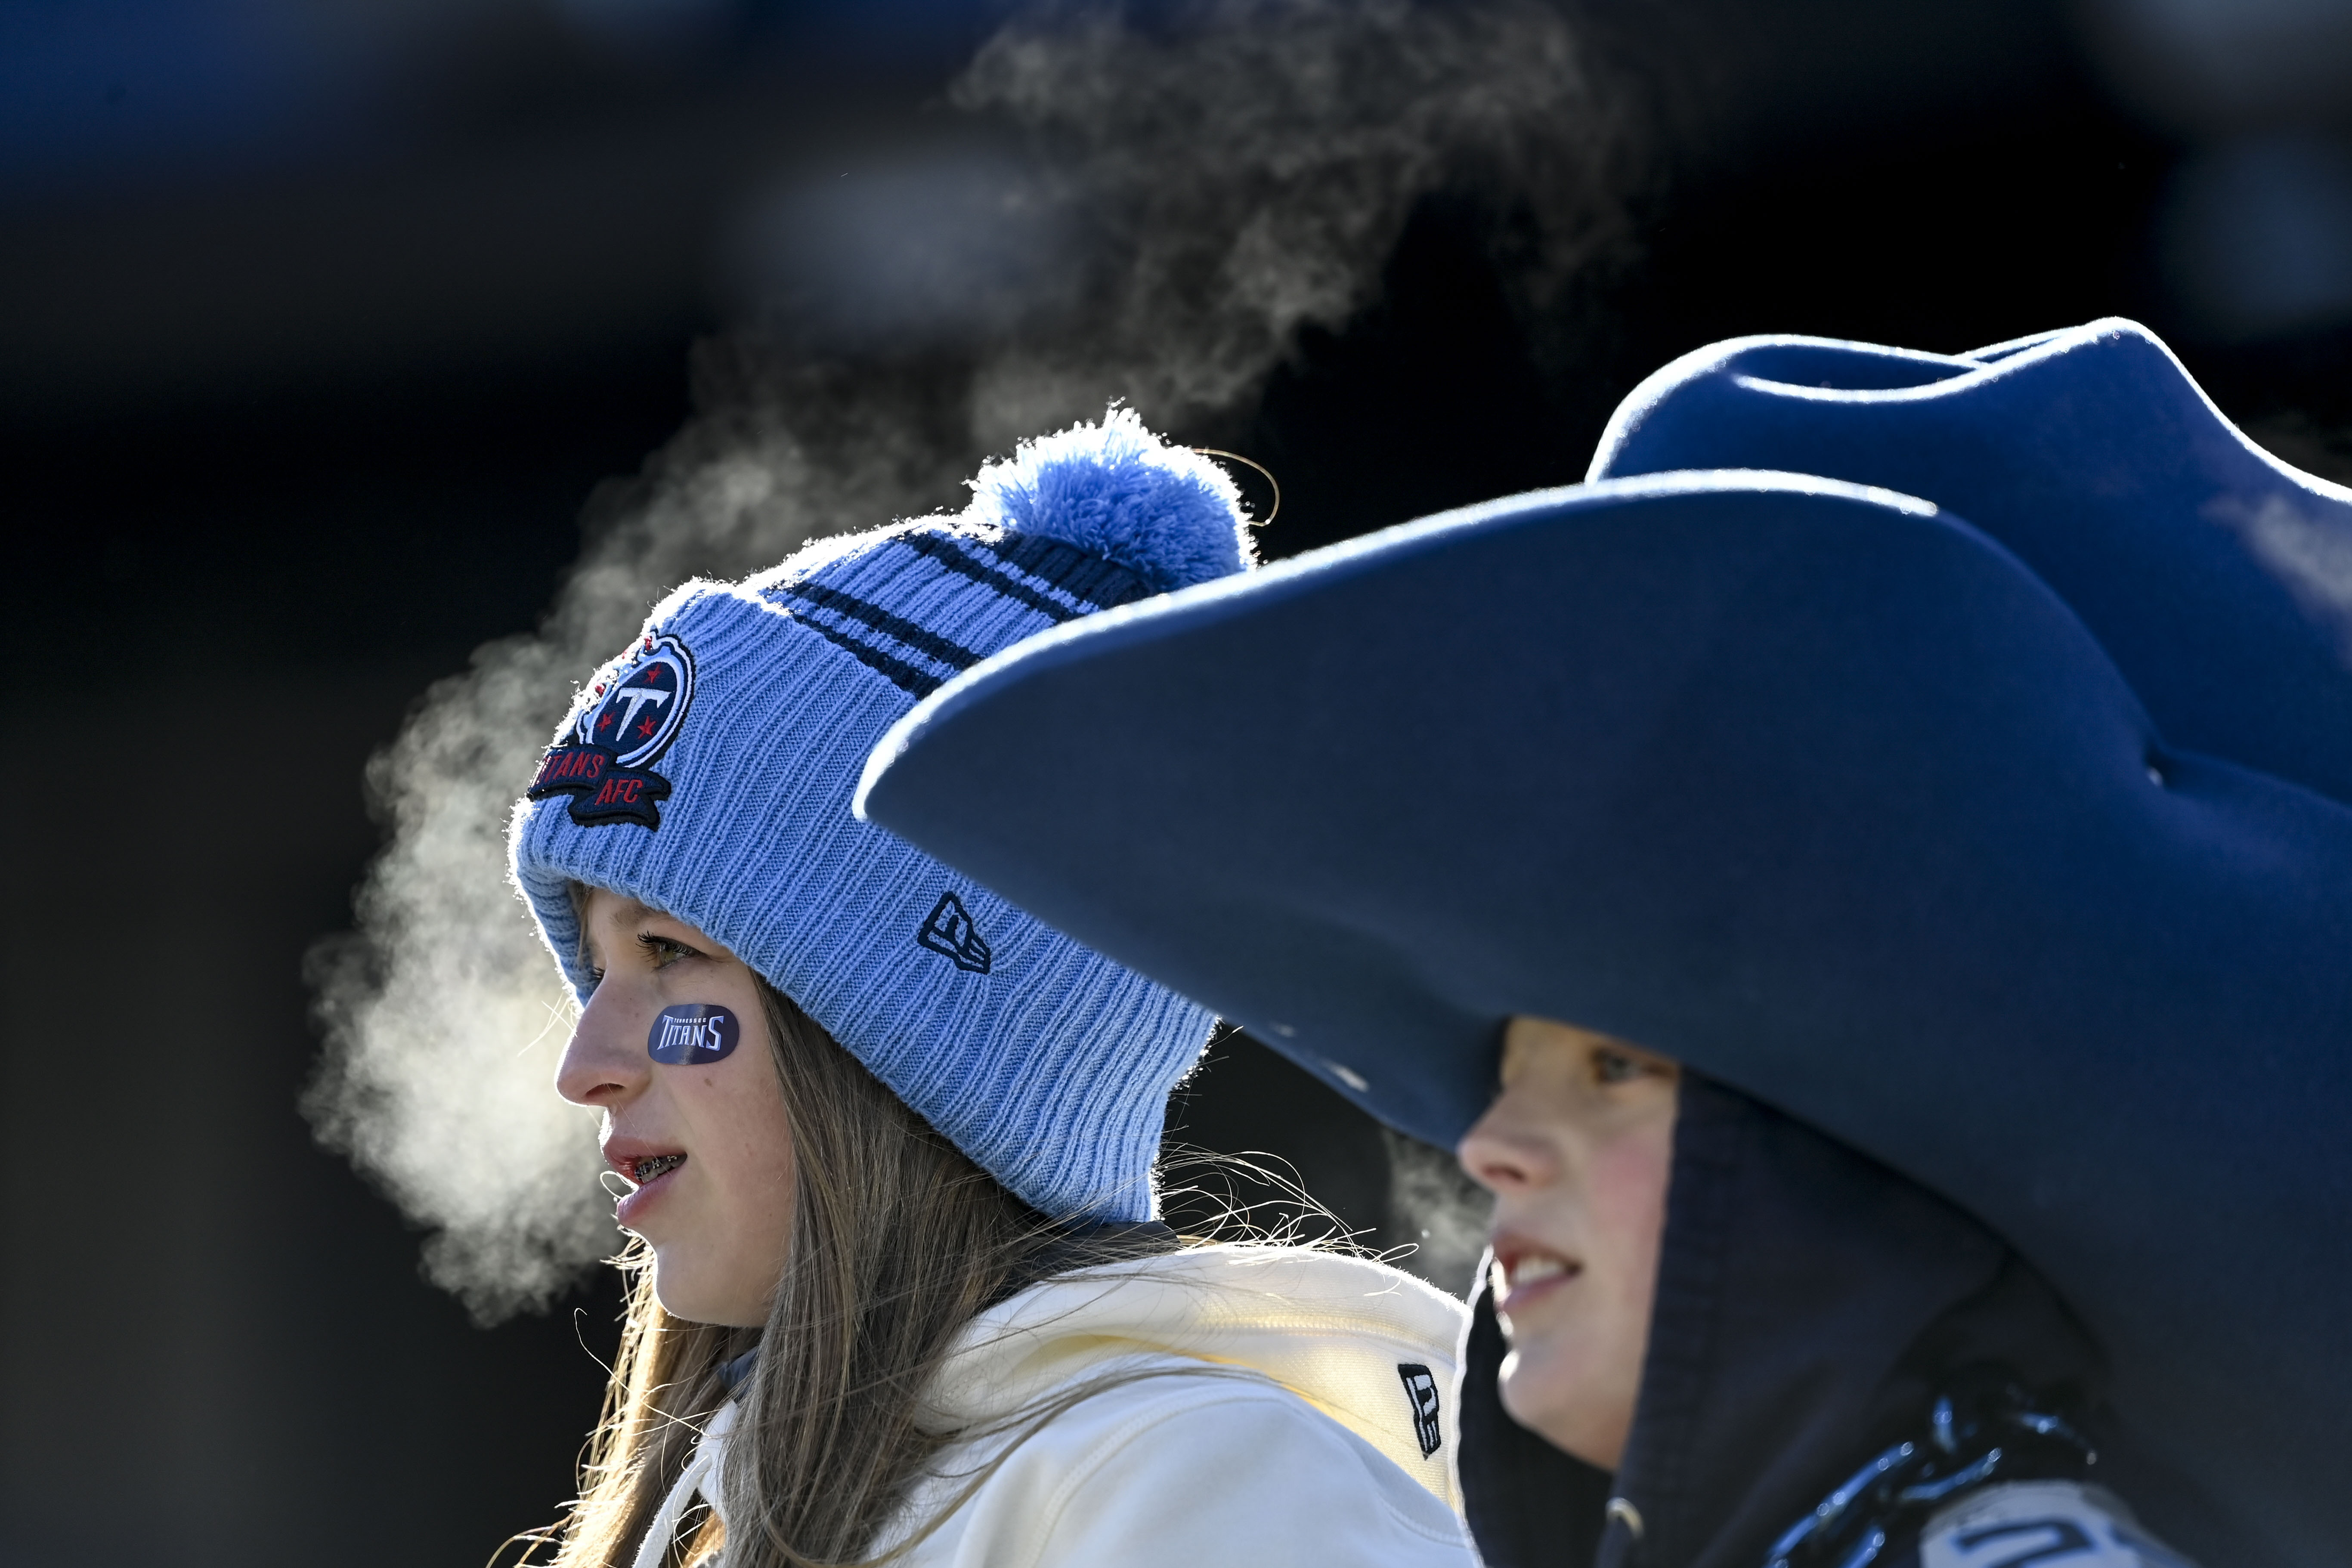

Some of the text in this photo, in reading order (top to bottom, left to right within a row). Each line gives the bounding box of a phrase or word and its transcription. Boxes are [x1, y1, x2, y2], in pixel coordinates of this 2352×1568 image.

[616, 687, 672, 742] T
[532, 752, 605, 786] ITANS
[595, 779, 643, 805] AFC
[656, 1014, 724, 1051] TITANS
